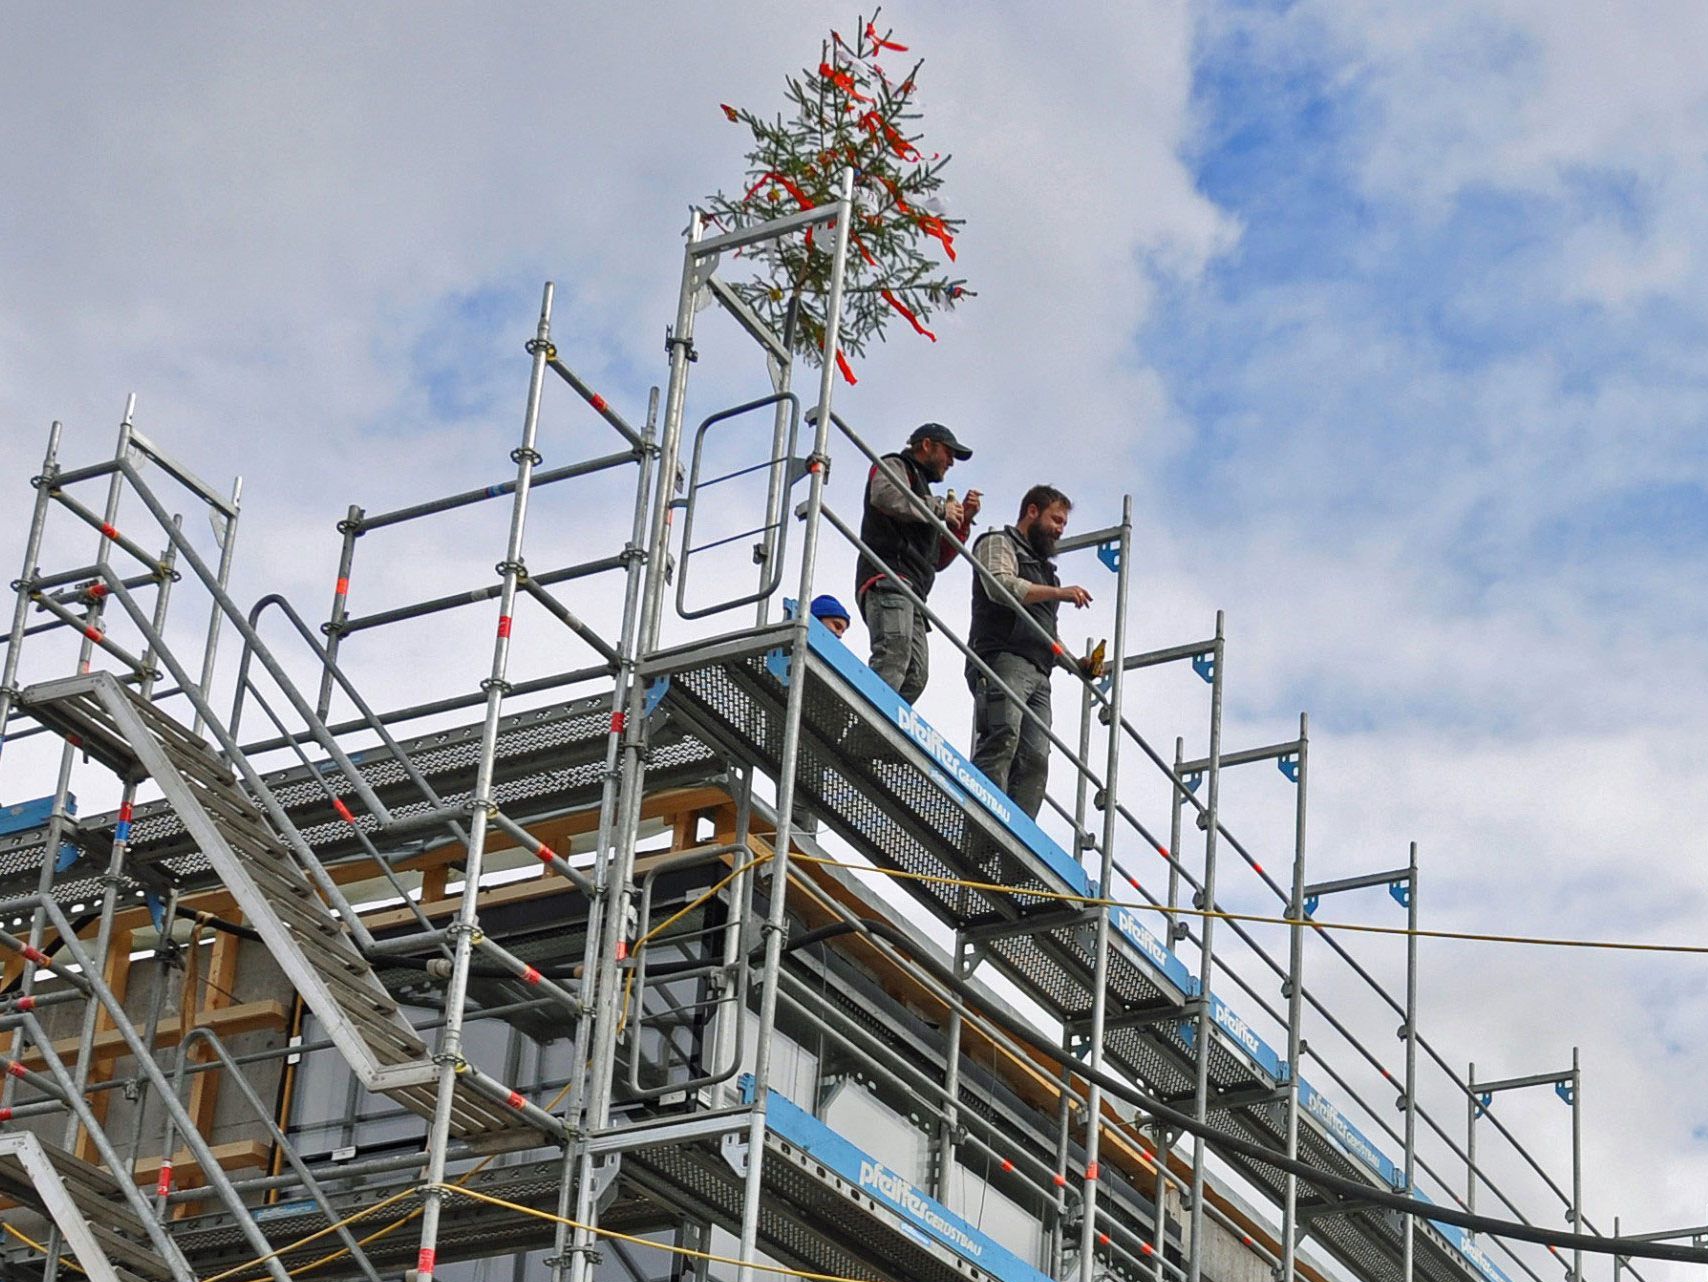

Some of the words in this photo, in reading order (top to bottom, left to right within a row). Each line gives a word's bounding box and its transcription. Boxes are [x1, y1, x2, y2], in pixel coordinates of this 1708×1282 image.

[898, 705, 960, 775] pfeiffer
[1118, 911, 1168, 966] pfeiffer
[1215, 1003, 1260, 1055] pfeiffer
[860, 1160, 928, 1220] pfeiffer
[925, 1210, 982, 1256] GERÜSTBAU
